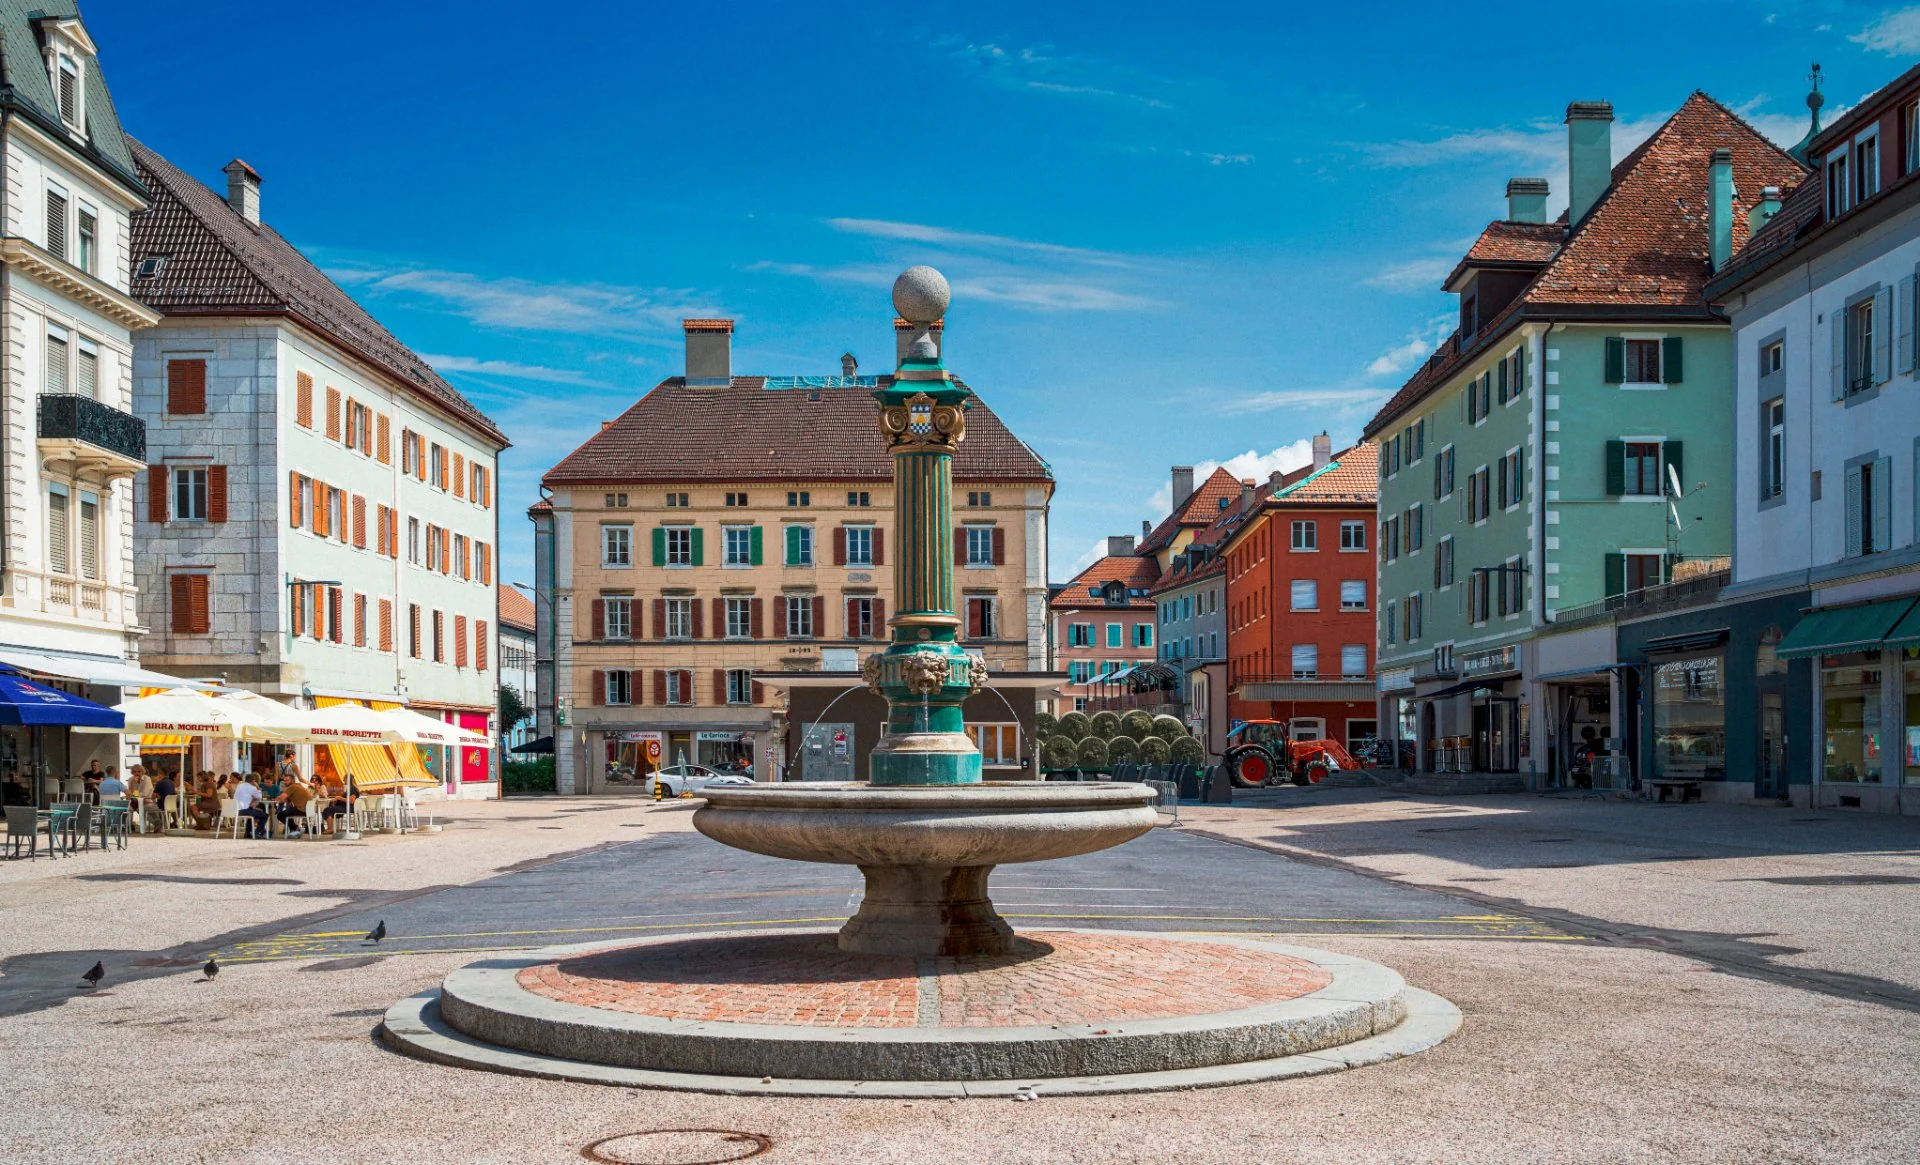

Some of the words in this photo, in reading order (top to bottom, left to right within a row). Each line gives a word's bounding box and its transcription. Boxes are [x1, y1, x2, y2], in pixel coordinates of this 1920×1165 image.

[145, 722, 174, 730] BIRRA
[177, 723, 220, 732] MORETTI
[311, 727, 339, 736] BIRRA
[342, 729, 382, 738] MORETTI
